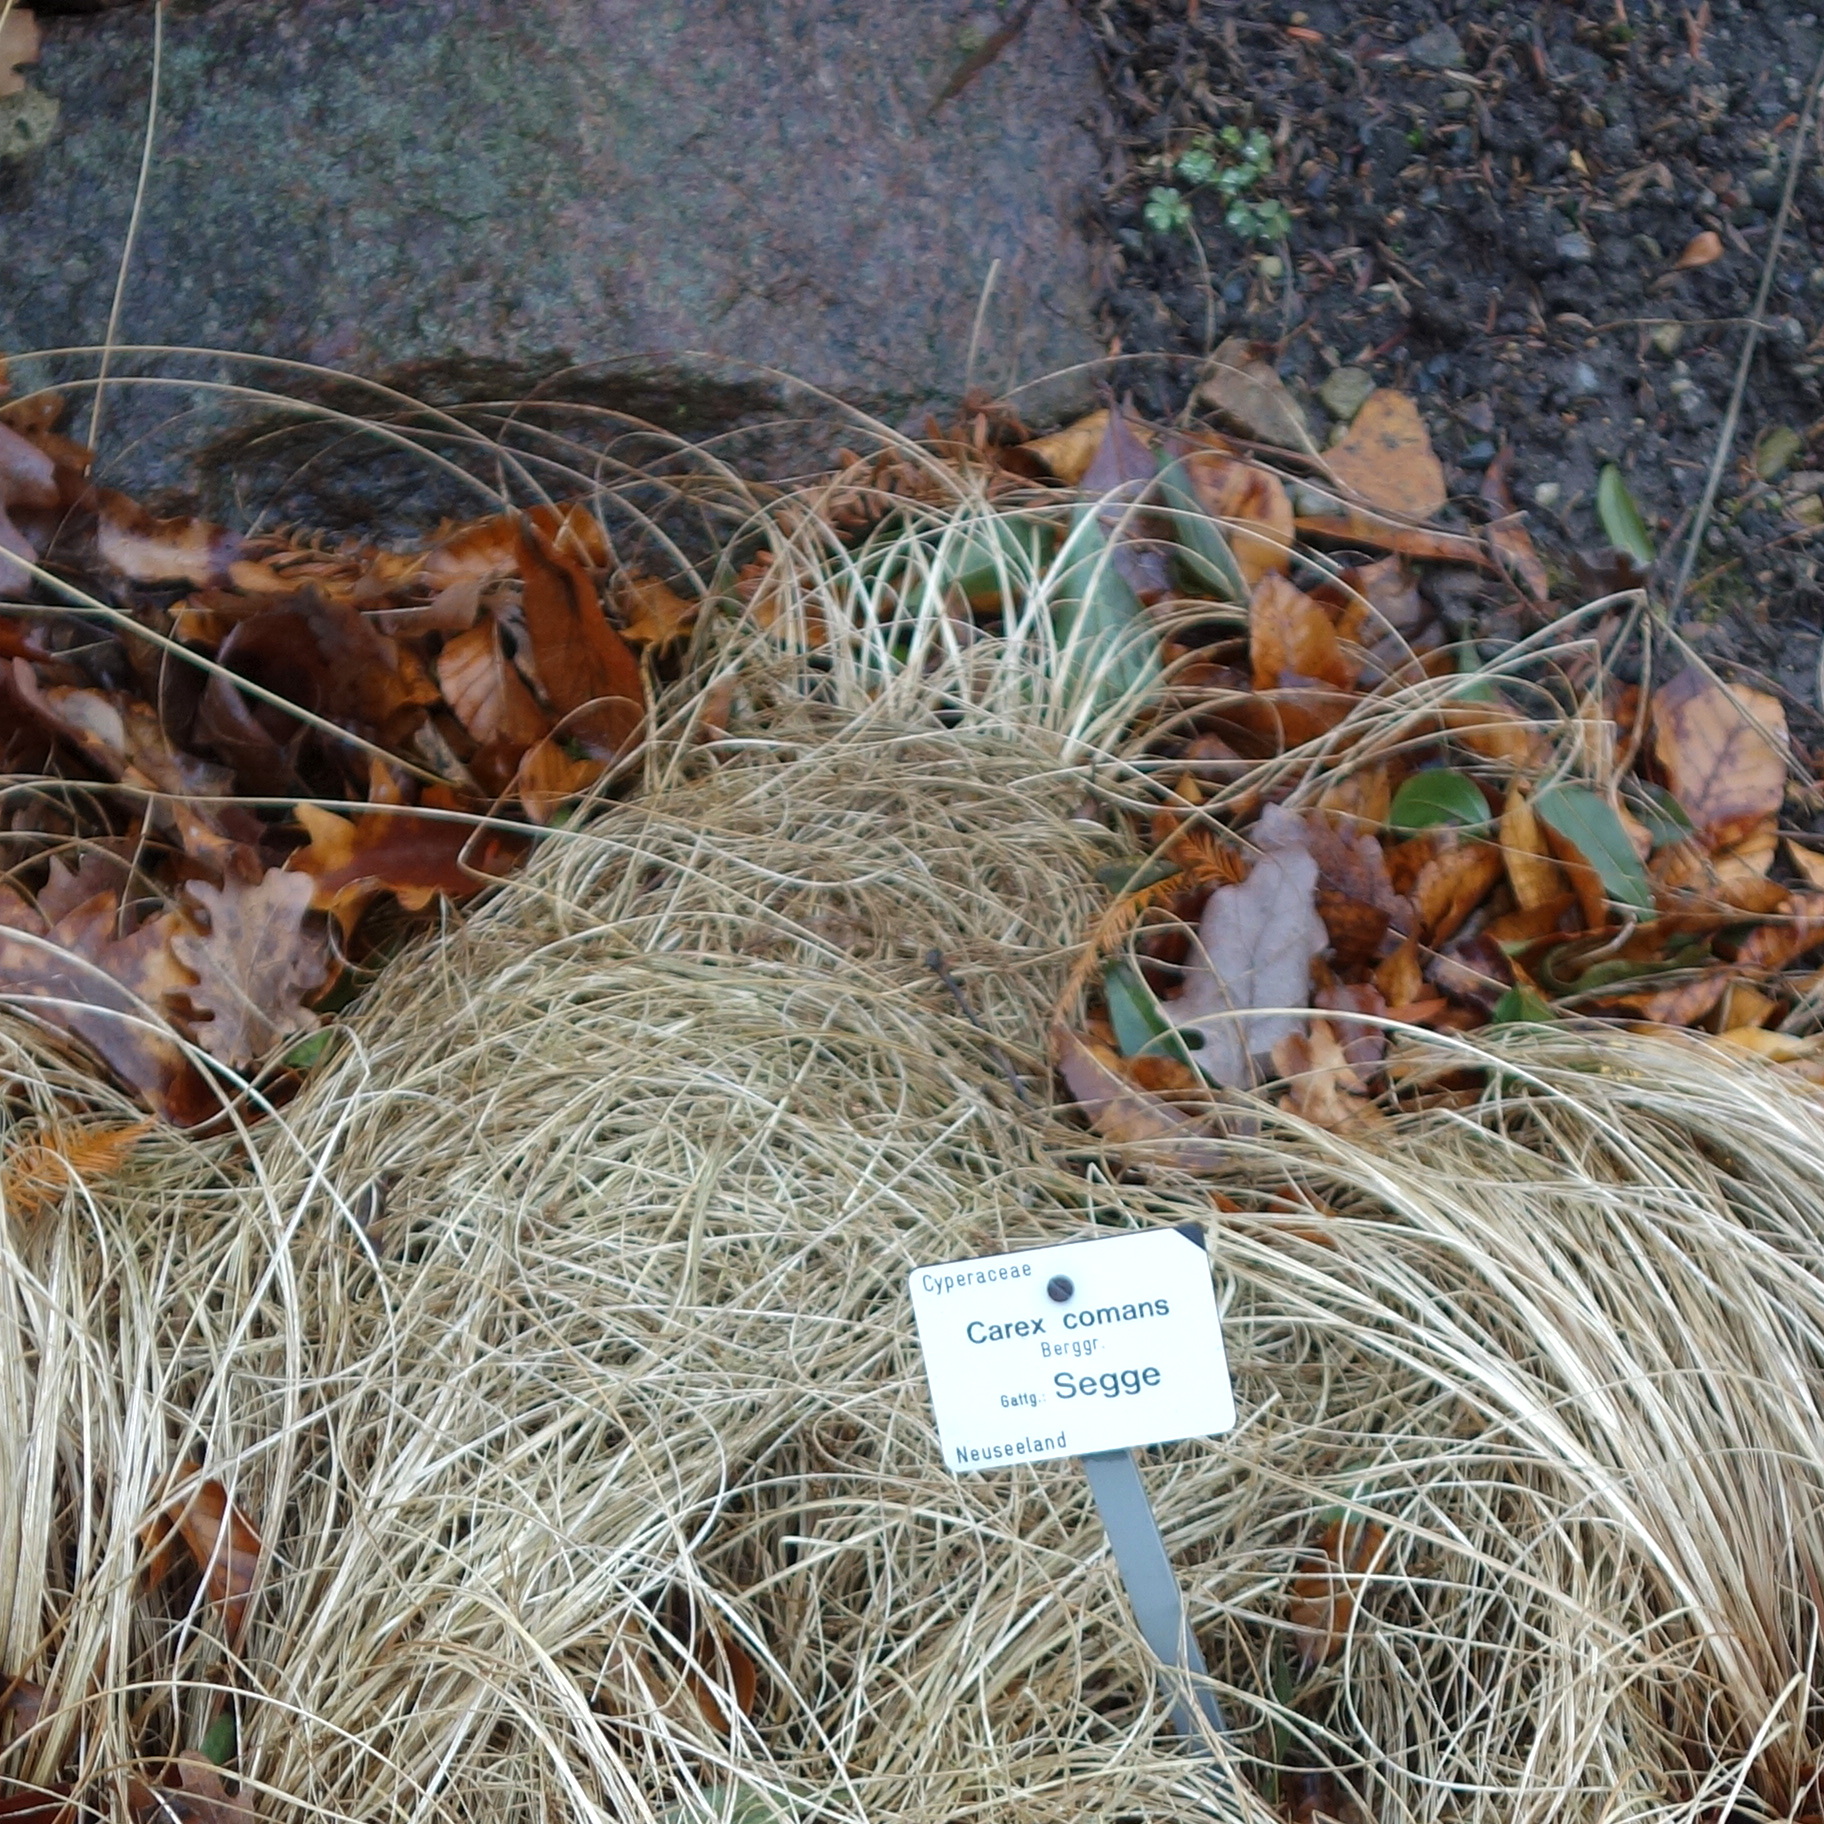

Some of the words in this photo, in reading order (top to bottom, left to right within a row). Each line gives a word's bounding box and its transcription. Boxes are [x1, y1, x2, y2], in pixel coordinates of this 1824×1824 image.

[922, 1263, 1033, 1295] Cyperaceae
[966, 1318, 1046, 1344] Carex
[1062, 1299, 1170, 1330] comans
[1041, 1338, 1106, 1358] Berggr.
[1053, 1366, 1162, 1399] Segge
[956, 1431, 1068, 1464] Neuseeland
